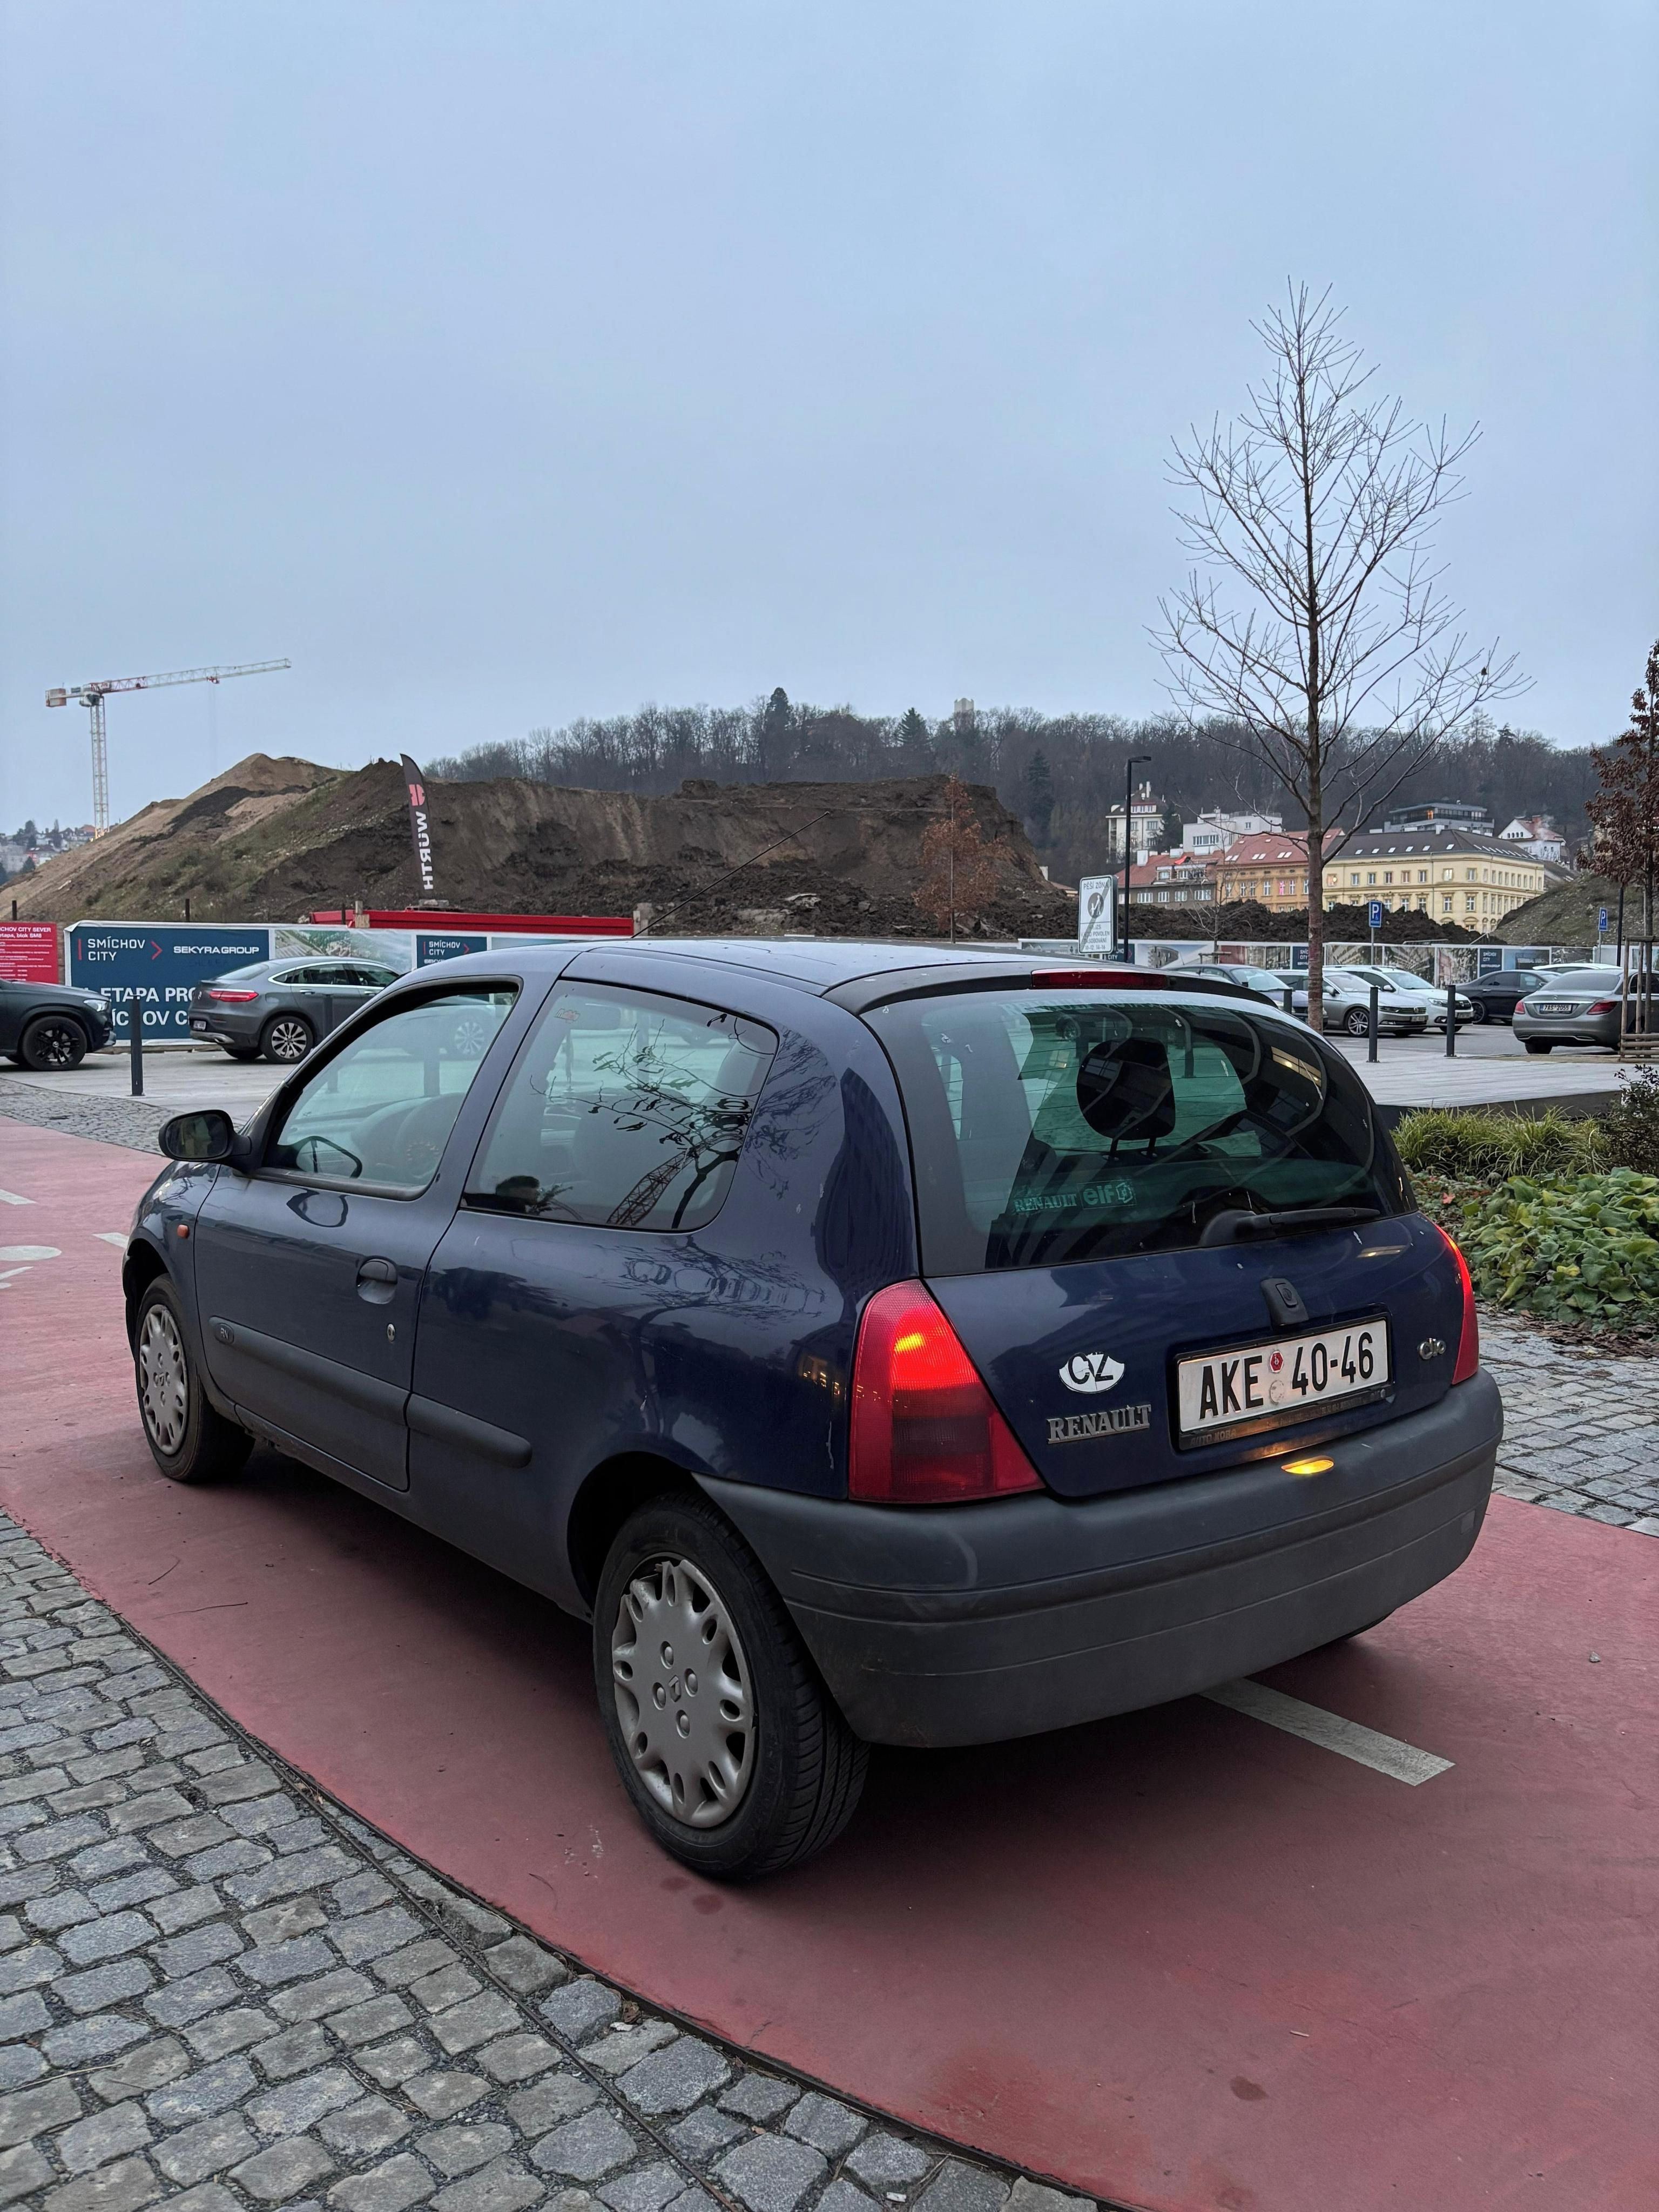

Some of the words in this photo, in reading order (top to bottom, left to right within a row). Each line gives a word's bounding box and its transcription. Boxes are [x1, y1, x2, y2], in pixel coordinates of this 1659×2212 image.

[1372, 904, 1379, 919] P
[1601, 911, 1606, 924] P
[87, 936, 145, 949] SMÍCHOV
[429, 940, 461, 949] SMÍCHOV
[88, 952, 117, 961] CITY
[1013, 1193, 1077, 1212] RENAULT
[1083, 1184, 1115, 1205] elf
[1068, 1352, 1114, 1384] CZ
[1199, 1355, 1264, 1420] AKE
[1292, 1332, 1374, 1395] 40-46
[1046, 1405, 1152, 1443] RENAULT
